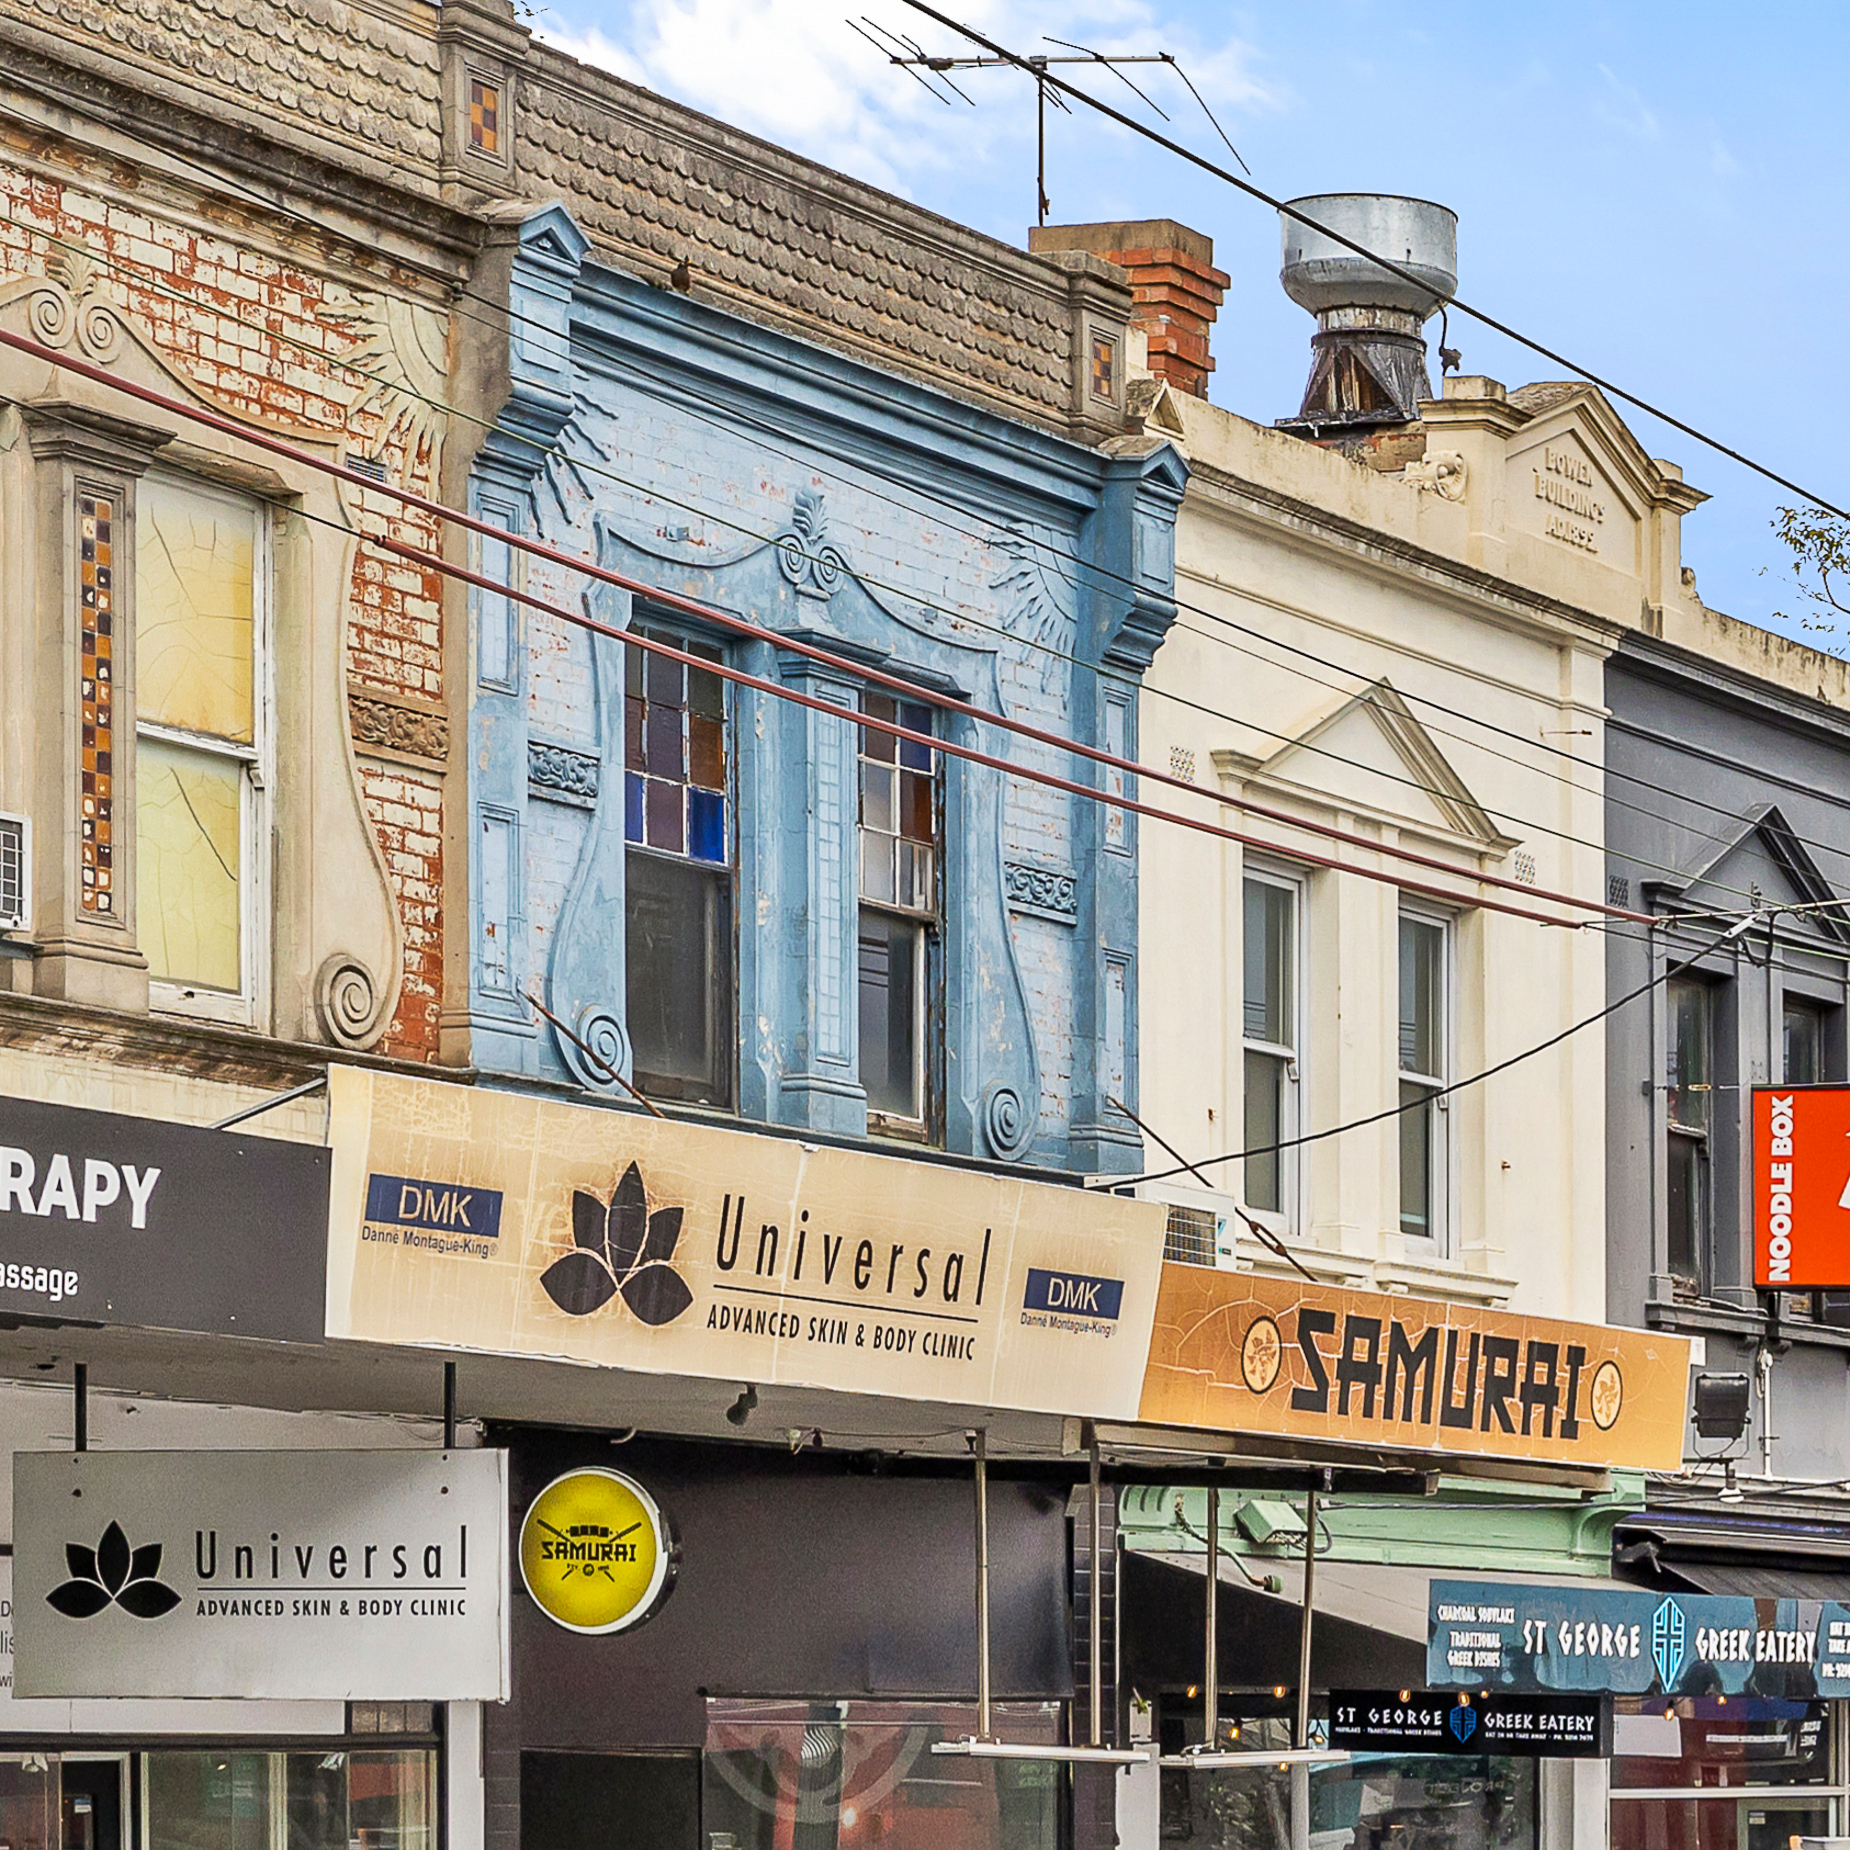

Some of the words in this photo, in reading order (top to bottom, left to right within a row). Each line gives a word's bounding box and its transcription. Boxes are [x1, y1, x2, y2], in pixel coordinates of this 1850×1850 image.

[1545, 447, 1593, 488] BOWEN
[1534, 474, 1605, 524] BUILDINGS
[1771, 1094, 1794, 1156] BOX
[398, 1184, 473, 1227] DMK
[1769, 1162, 1792, 1281] NOODLE
[716, 1194, 992, 1305] Universal
[1047, 1278, 1101, 1311] DMK
[707, 1305, 800, 1340] ADVANCED
[808, 1317, 848, 1346] SKIN
[855, 1323, 866, 1347] &
[873, 1325, 916, 1354] BODY
[922, 1332, 976, 1361] CLINIC
[1291, 1307, 1586, 1440] SAMURAI
[195, 1525, 466, 1580] Universal
[541, 1541, 637, 1562] SAMURAI
[196, 1599, 284, 1616] ADVANCED
[293, 1599, 331, 1616] SKIN
[339, 1599, 350, 1616] &
[358, 1599, 402, 1616] BODY
[410, 1599, 467, 1616] CLINIC
[1522, 1620, 1547, 1654] ST
[1558, 1621, 1641, 1658] GEORGE
[1695, 1627, 1750, 1662] GREEK
[1756, 1630, 1817, 1665] EATERY
[1337, 1707, 1356, 1723] ST
[1368, 1708, 1442, 1726] GEORGE
[1484, 1712, 1533, 1730] GREEK
[1539, 1715, 1595, 1732] EATERY
